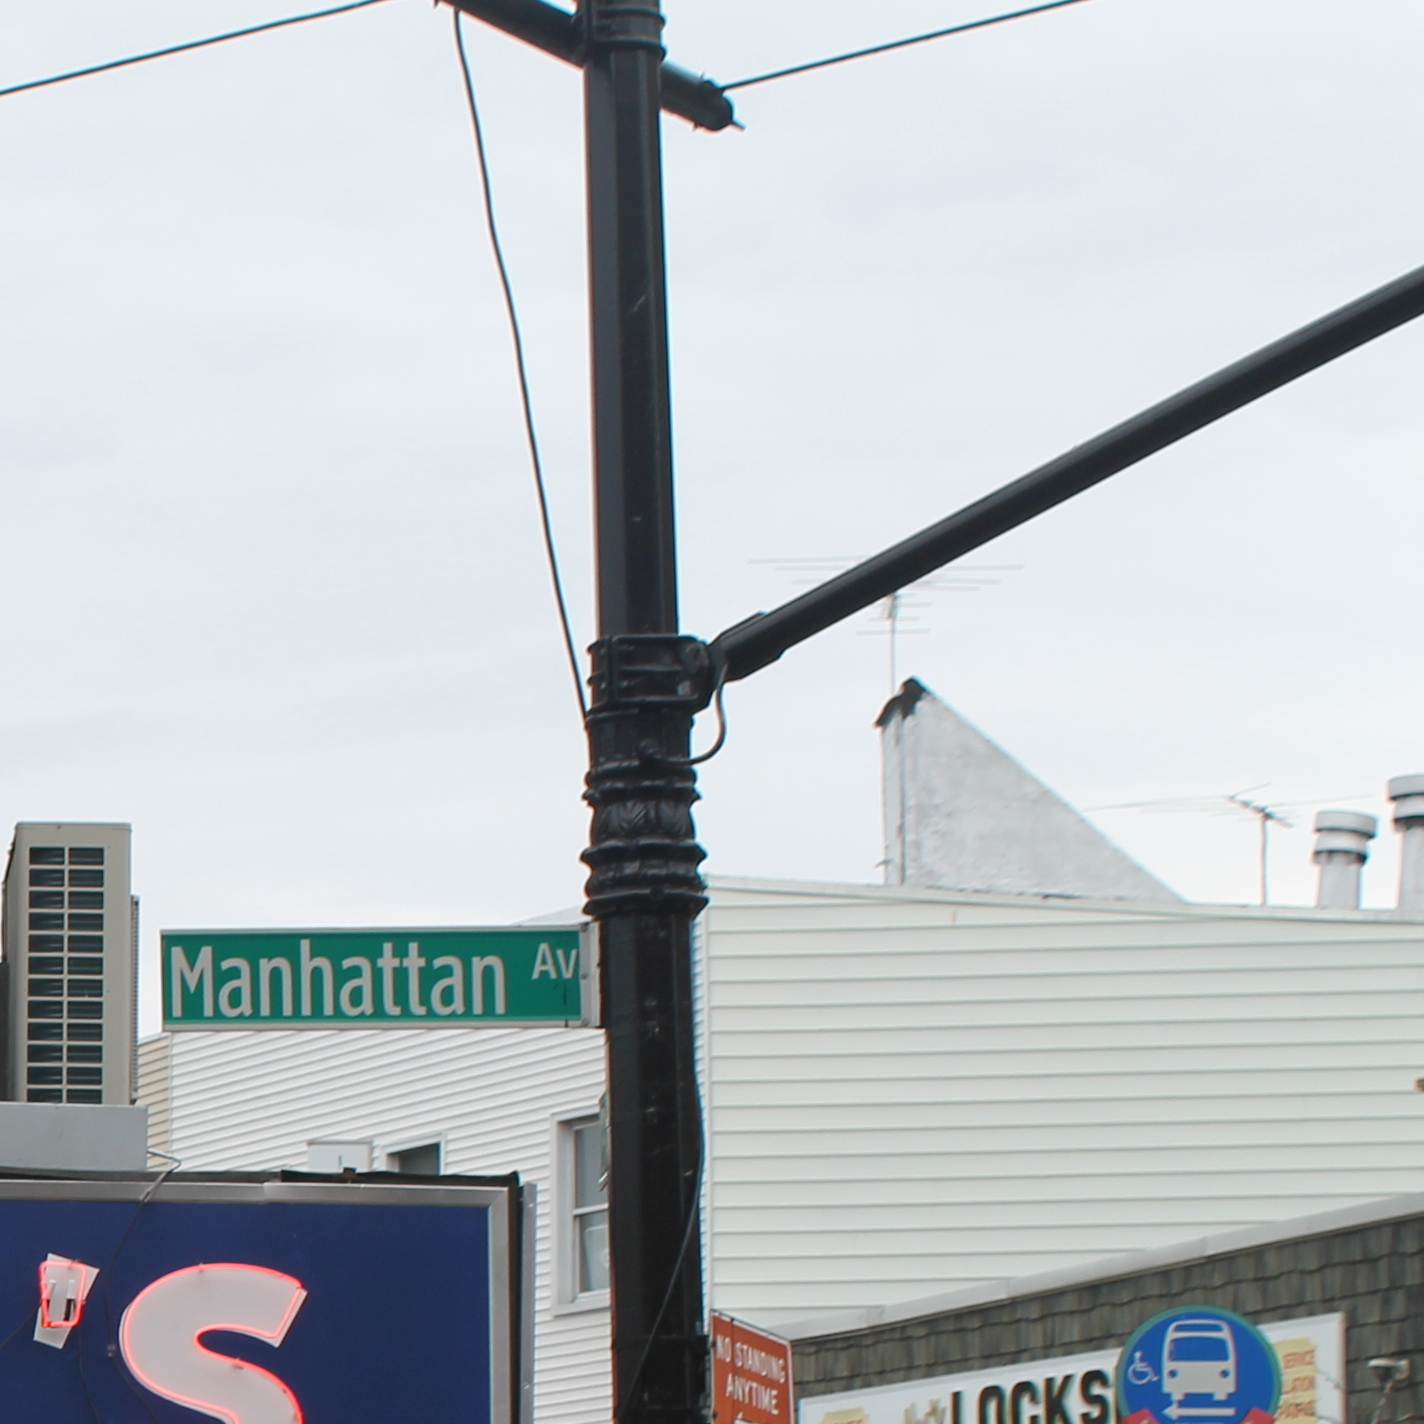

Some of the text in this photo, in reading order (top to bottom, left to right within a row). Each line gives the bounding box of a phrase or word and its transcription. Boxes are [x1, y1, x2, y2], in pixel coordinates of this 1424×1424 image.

[170, 938, 578, 1019] Manhattan Av
[715, 1334, 786, 1384] NO STANDING
[725, 1372, 780, 1416] ANYTIME
